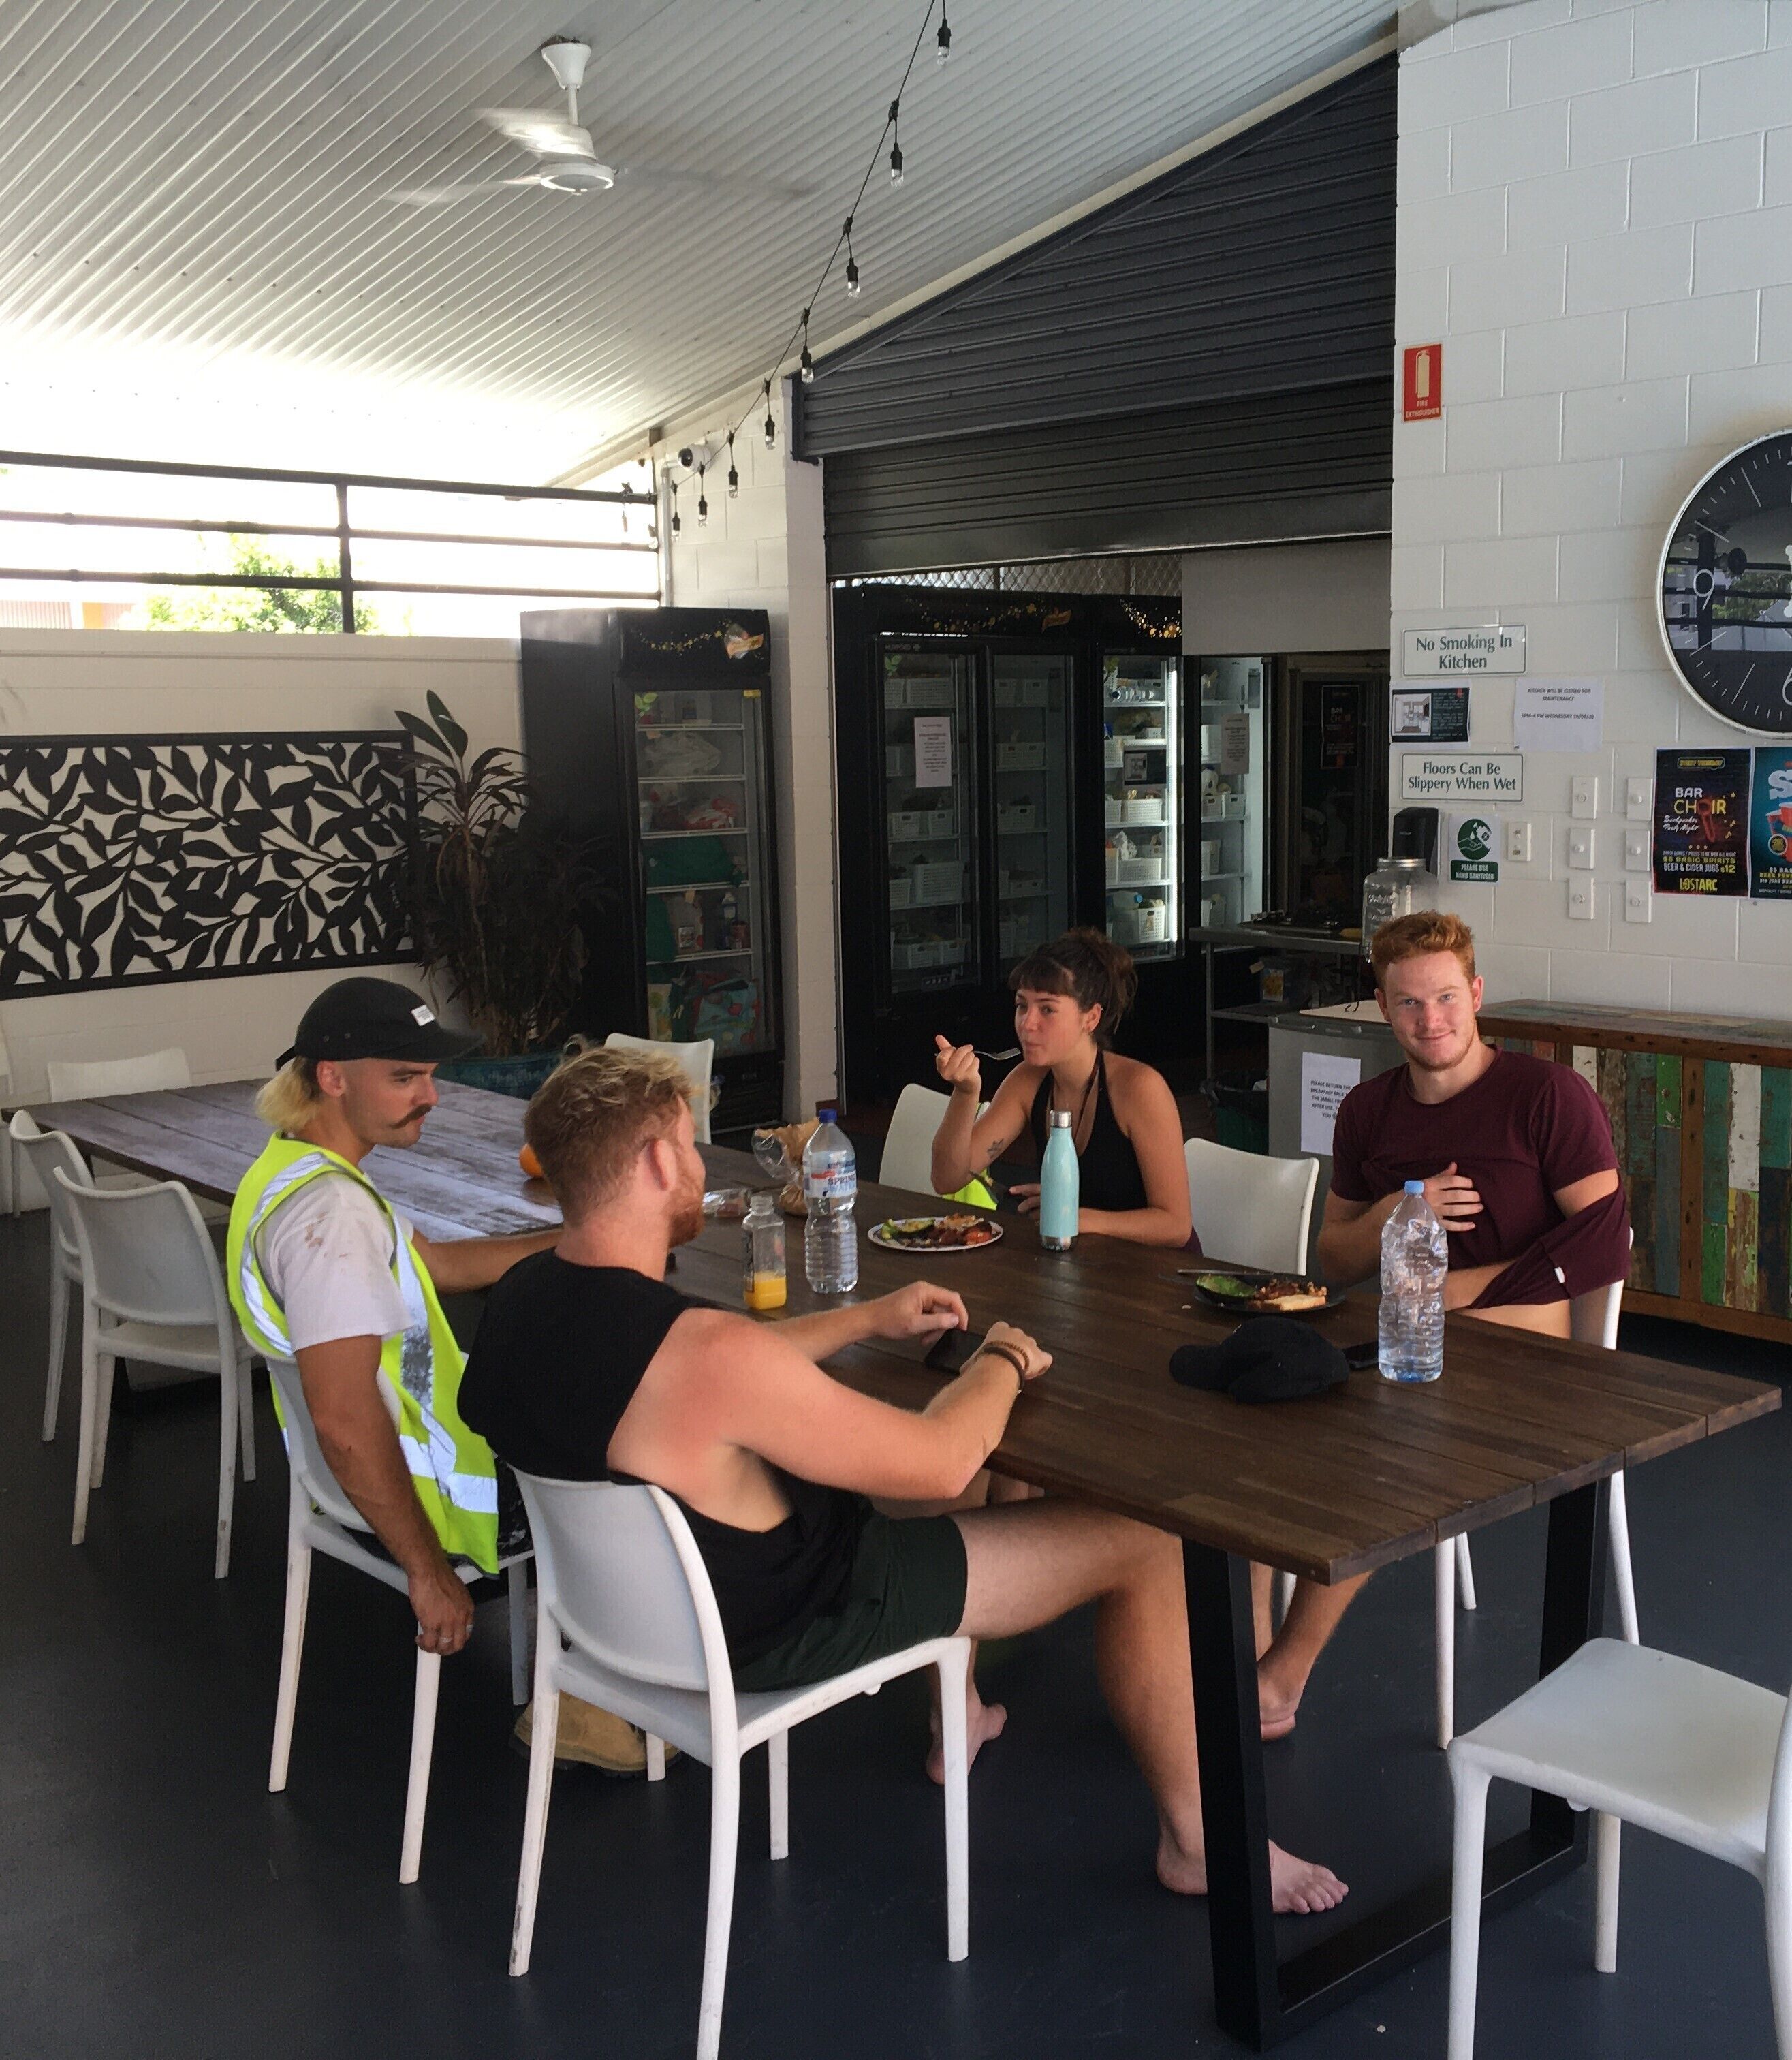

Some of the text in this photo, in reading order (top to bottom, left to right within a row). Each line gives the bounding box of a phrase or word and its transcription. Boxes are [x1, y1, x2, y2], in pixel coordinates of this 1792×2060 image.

[1693, 569, 1715, 610] 9
[1416, 634, 1512, 653] No Smoking In
[1439, 653, 1487, 669] Kitchen
[1423, 762, 1500, 775] Floors Can Be
[1409, 775, 1515, 793] Slippery When Wet
[1675, 787, 1703, 798] BAR
[1663, 863, 1735, 873] BEER & CIDER JUGS $12
